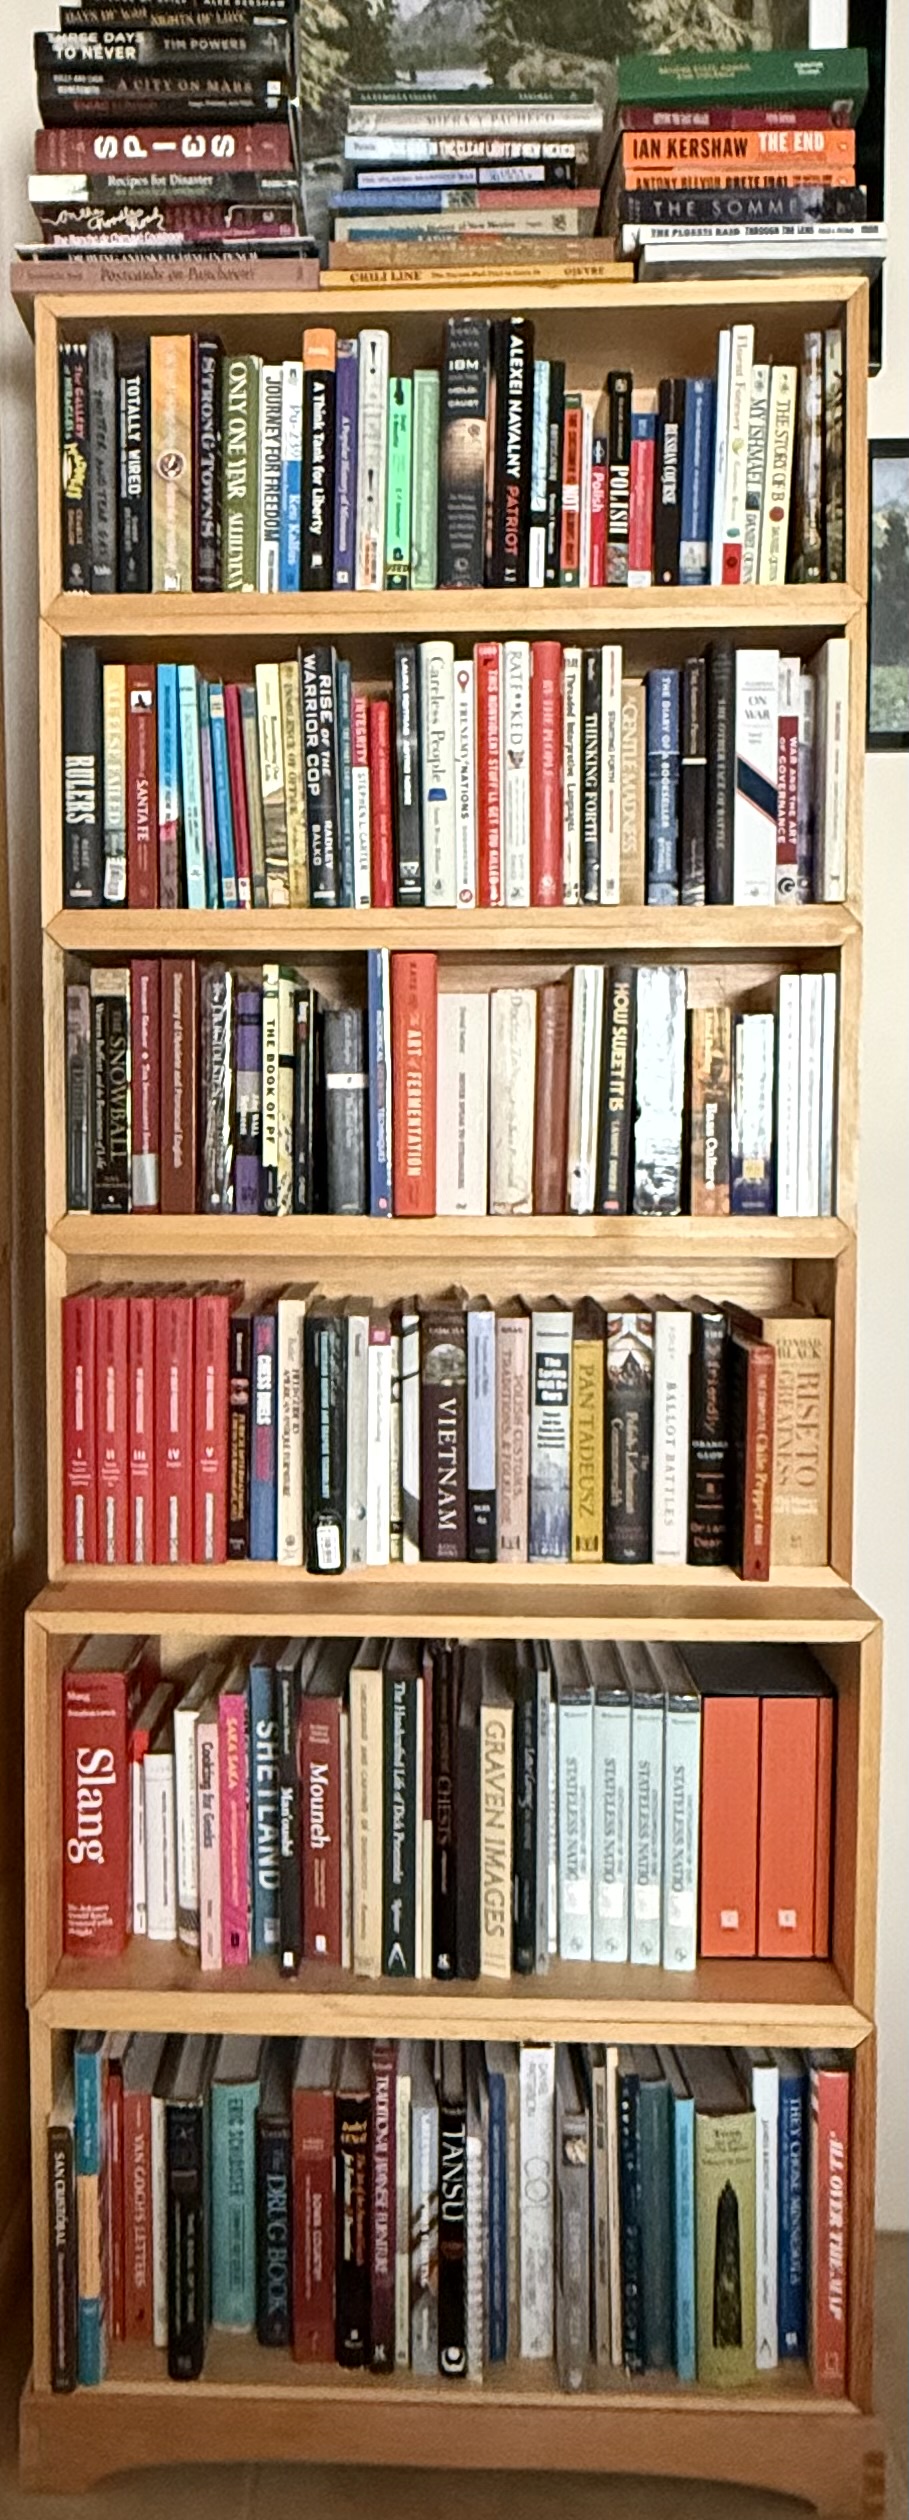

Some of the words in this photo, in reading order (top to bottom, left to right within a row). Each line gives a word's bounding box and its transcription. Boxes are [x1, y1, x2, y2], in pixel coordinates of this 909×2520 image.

[56, 47, 77, 60] TO
[82, 47, 136, 60] NEVER
[103, 32, 144, 43] DAYS
[164, 39, 185, 50] TIM
[190, 39, 247, 50] POWERS
[117, 79, 127, 91] A
[133, 78, 171, 92] CITY
[178, 79, 200, 91] ON
[206, 79, 253, 93] MARS
[94, 134, 235, 158] SPIES
[632, 139, 661, 160] IAN
[667, 138, 748, 160] KERSHAW
[758, 131, 788, 152] THE
[794, 131, 825, 152] END
[107, 174, 148, 189] Recipes
[151, 174, 166, 186] for
[170, 174, 213, 187] Disaster
[653, 201, 695, 217] THE
[712, 200, 797, 218] SOMME
[651, 229, 669, 238] THE
[716, 227, 740, 237] RAID
[350, 272, 388, 283] CHILI
[391, 270, 422, 282] LINE
[449, 359, 479, 371] IBM
[509, 335, 523, 394] ALEXEI
[64, 377, 74, 431] MIRACLES
[127, 376, 142, 441] TOTALLY
[201, 356, 218, 449] STRONG
[227, 362, 247, 412] ONLY
[264, 376, 280, 441] JOURNEY
[313, 382, 324, 392] A
[74, 387, 84, 440] GALLERY
[313, 394, 326, 429] Think
[749, 398, 767, 420] MY
[776, 399, 790, 428] THE
[227, 418, 247, 454] ONE
[313, 432, 325, 464] Tank
[507, 399, 521, 478] NAVALNY
[746, 425, 763, 485] ISHMAEL
[774, 430, 788, 471] STORY
[127, 449, 142, 497] WIRED
[227, 458, 247, 500] YEAR
[264, 446, 280, 472] FOR
[313, 466, 326, 485] for
[773, 473, 787, 488] OF
[201, 458, 218, 537] TOWNS
[264, 475, 280, 541] FREEDOM
[288, 494, 299, 520] Ken
[310, 488, 326, 534] Liberty
[561, 484, 579, 511] NOT
[592, 472, 604, 512] Polish
[609, 465, 629, 534] POLISH
[772, 493, 786, 502] B
[505, 486, 519, 555] PATRIOT
[107, 680, 122, 710] ALL
[304, 653, 318, 746] WARRIOR
[319, 675, 332, 723] RISE
[430, 656, 445, 724] Careless
[488, 669, 499, 692] THIS
[565, 673, 576, 717] Threaded
[662, 676, 671, 698] THE
[354, 698, 368, 766] INTEGRITY
[543, 700, 554, 723] THE
[662, 700, 671, 731] DIARY
[107, 721, 122, 760] ELSE
[321, 728, 330, 746] OF
[427, 730, 446, 783] People
[543, 728, 554, 776] PEOPLE
[585, 712, 598, 786] THINKING
[622, 703, 637, 770] GENTLE
[789, 736, 797, 764] WAR
[308, 753, 320, 796] COP
[322, 751, 330, 776] THE
[789, 768, 797, 790] AND
[65, 755, 96, 824] RULERS
[107, 763, 122, 824] FAILED
[136, 779, 149, 821] SANTA
[358, 773, 367, 819] STEPHEN
[461, 765, 469, 819] NATIONS
[662, 762, 671, 828] BOOKSELLER
[789, 796, 797, 816] THE
[136, 825, 149, 841] FE
[488, 806, 499, 825] GET
[585, 791, 598, 843] FORTH
[622, 772, 637, 852] MADNESS
[789, 821, 797, 844] ART
[313, 824, 323, 866] BALKO
[324, 820, 333, 869] RADLEY
[359, 833, 368, 871] CARTER
[488, 828, 499, 848] YOU
[614, 983, 629, 1025] HOW
[267, 1019, 275, 1047] THE
[407, 1029, 422, 1057] ART
[611, 1027, 627, 1079] SWEET
[267, 1053, 275, 1096] BOOK
[610, 1081, 625, 1097] IT
[110, 1035, 127, 1163] SNOWBALL
[267, 1102, 275, 1120] OF
[609, 1098, 624, 1112] IS
[267, 1125, 275, 1145] PF
[407, 1071, 422, 1177] FERMENTATION
[777, 1348, 821, 1359] BLACK
[513, 1375, 523, 1426] POLISH
[579, 1364, 595, 1409] PAN
[703, 1360, 720, 1434] friendly
[795, 1371, 821, 1439] RISE
[665, 1382, 675, 1444] BALLOT
[778, 1370, 793, 1487] GREATNESS
[437, 1398, 457, 1531] VIETNAM
[579, 1413, 595, 1518] TADEUSZ
[756, 1433, 768, 1470] Chile
[795, 1441, 821, 1488] TO
[664, 1455, 675, 1527] BATTLES
[752, 1473, 768, 1520] Pepper
[394, 1681, 406, 1702] The
[227, 1718, 238, 1751] SAKA
[200, 1742, 213, 1790] Cooking
[484, 1720, 506, 1828] GRAVEN
[67, 1748, 116, 1864] Slang
[202, 1793, 214, 1810] for
[257, 1720, 277, 1890] SHETLAND
[310, 1762, 331, 1849] Mouneh
[394, 1804, 406, 1829] Dick
[437, 1776, 451, 1845] CHESTS
[567, 1757, 578, 1836] STATELESS
[604, 1758, 616, 1836] STATELESS
[638, 1760, 650, 1838] STATELESS
[673, 1766, 685, 1846] STATELESS
[202, 1812, 214, 1849] Geeks
[484, 1838, 506, 1937] IMAGES
[375, 2075, 389, 2153] TRADITIONAL
[790, 2098, 802, 2136] THEY
[54, 2152, 65, 2178] SAN
[134, 2133, 145, 2164] VAN
[790, 2141, 802, 2192] CHOSE
[442, 2124, 466, 2222] TANSU
[267, 2174, 287, 2241] DRUG
[829, 2175, 843, 2227] OVER
[134, 2225, 145, 2288] LETTERS
[829, 2232, 843, 2264] THE
[267, 2247, 287, 2315] BOOK
